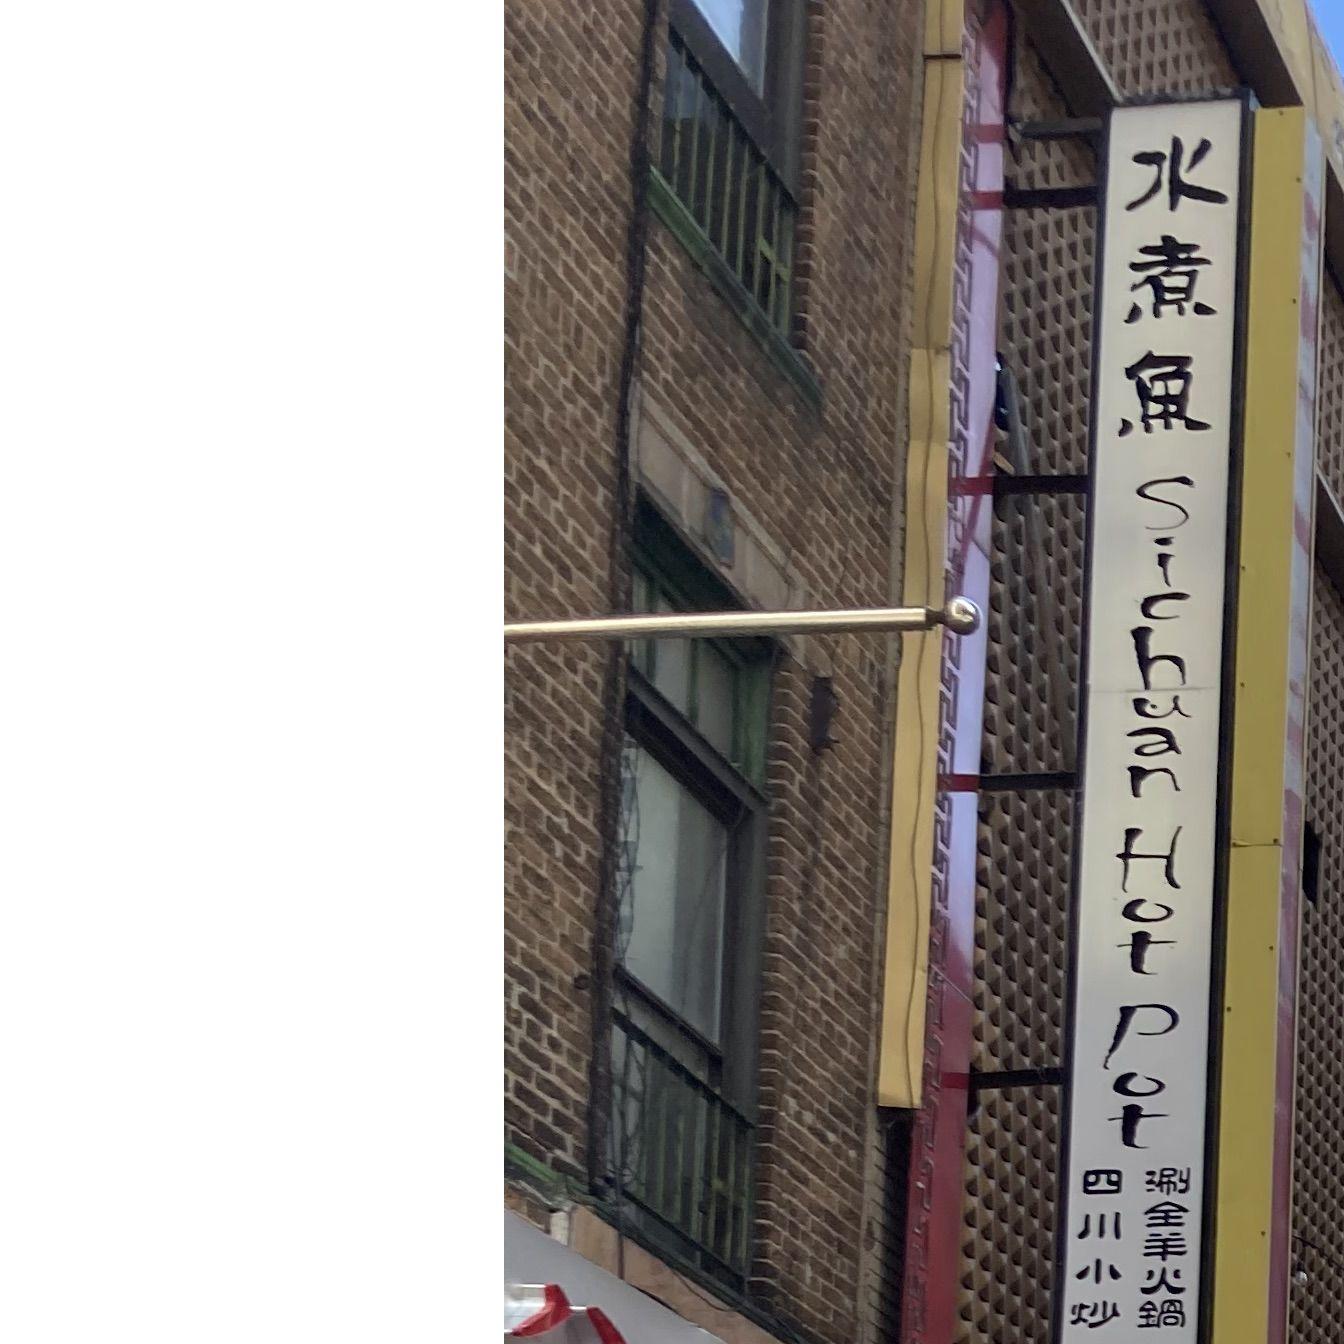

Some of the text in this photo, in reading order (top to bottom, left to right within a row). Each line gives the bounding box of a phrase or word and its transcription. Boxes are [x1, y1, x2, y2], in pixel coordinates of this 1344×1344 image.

[1116, 136, 1228, 437] 水煮魚
[1102, 475, 1193, 1150] Sichuan Hot Pot
[1068, 1167, 1123, 1328] 四川小炒
[1136, 1166, 1191, 1330] 涮全羊火鍋
